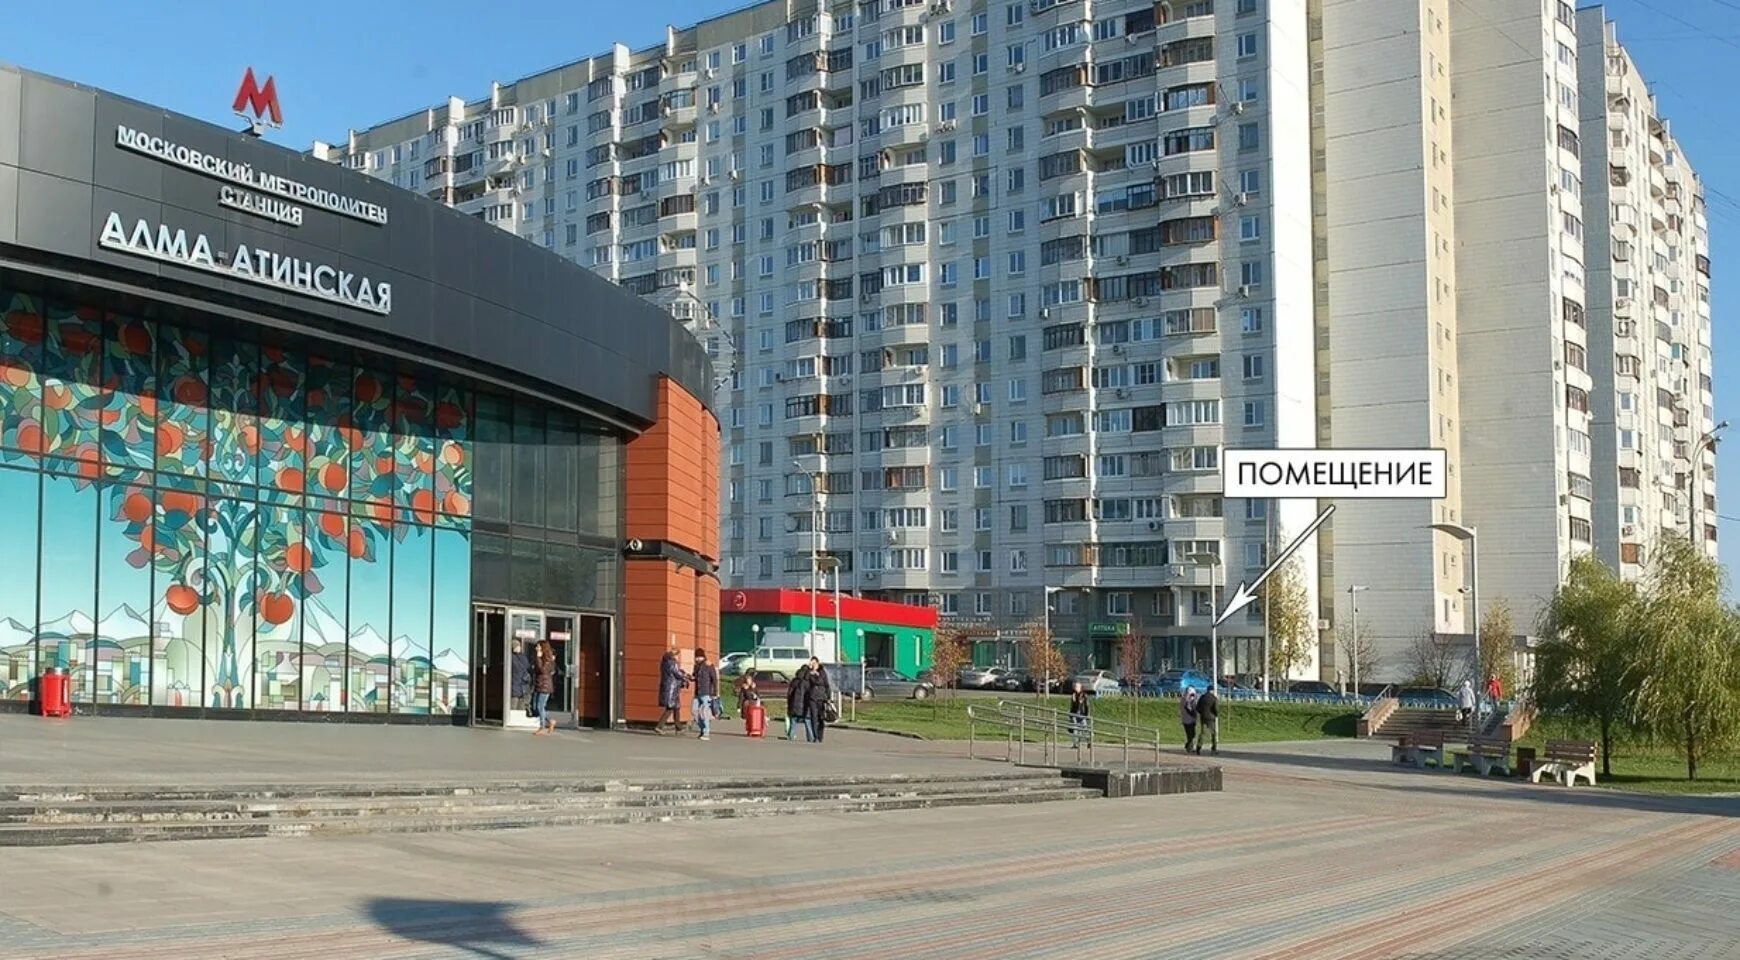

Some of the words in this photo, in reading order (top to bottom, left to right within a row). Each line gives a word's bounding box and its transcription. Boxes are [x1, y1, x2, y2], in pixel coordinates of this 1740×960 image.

[116, 125, 253, 183] МОСКОВСКИЙ
[260, 172, 388, 224] МЕТРОПОЛИТЕН
[219, 186, 302, 225] СТАНЦИЯ
